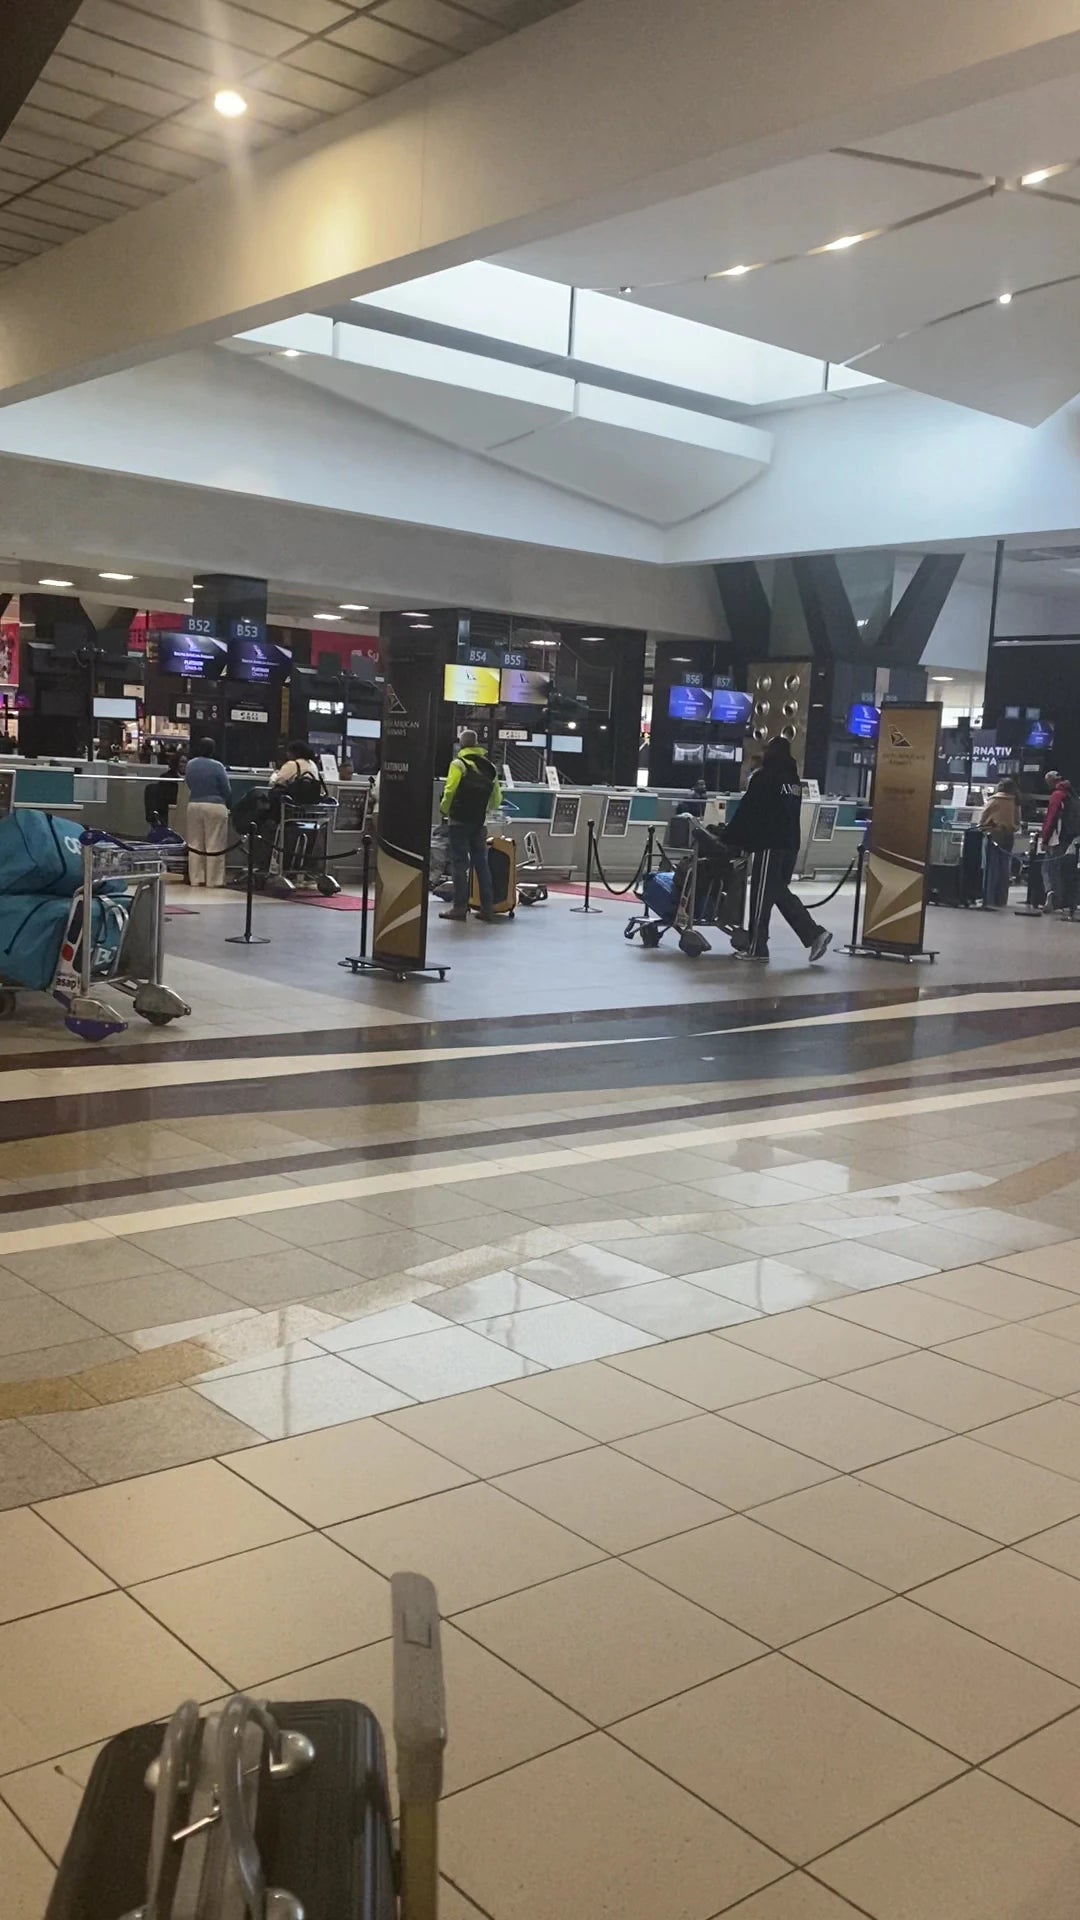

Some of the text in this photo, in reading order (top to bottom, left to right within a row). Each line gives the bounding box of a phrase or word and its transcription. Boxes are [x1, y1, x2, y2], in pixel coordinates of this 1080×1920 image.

[188, 618, 211, 633] B52
[236, 624, 258, 638] B53
[469, 650, 487, 662] B54
[504, 654, 521, 666] B55
[685, 673, 701, 685] B56
